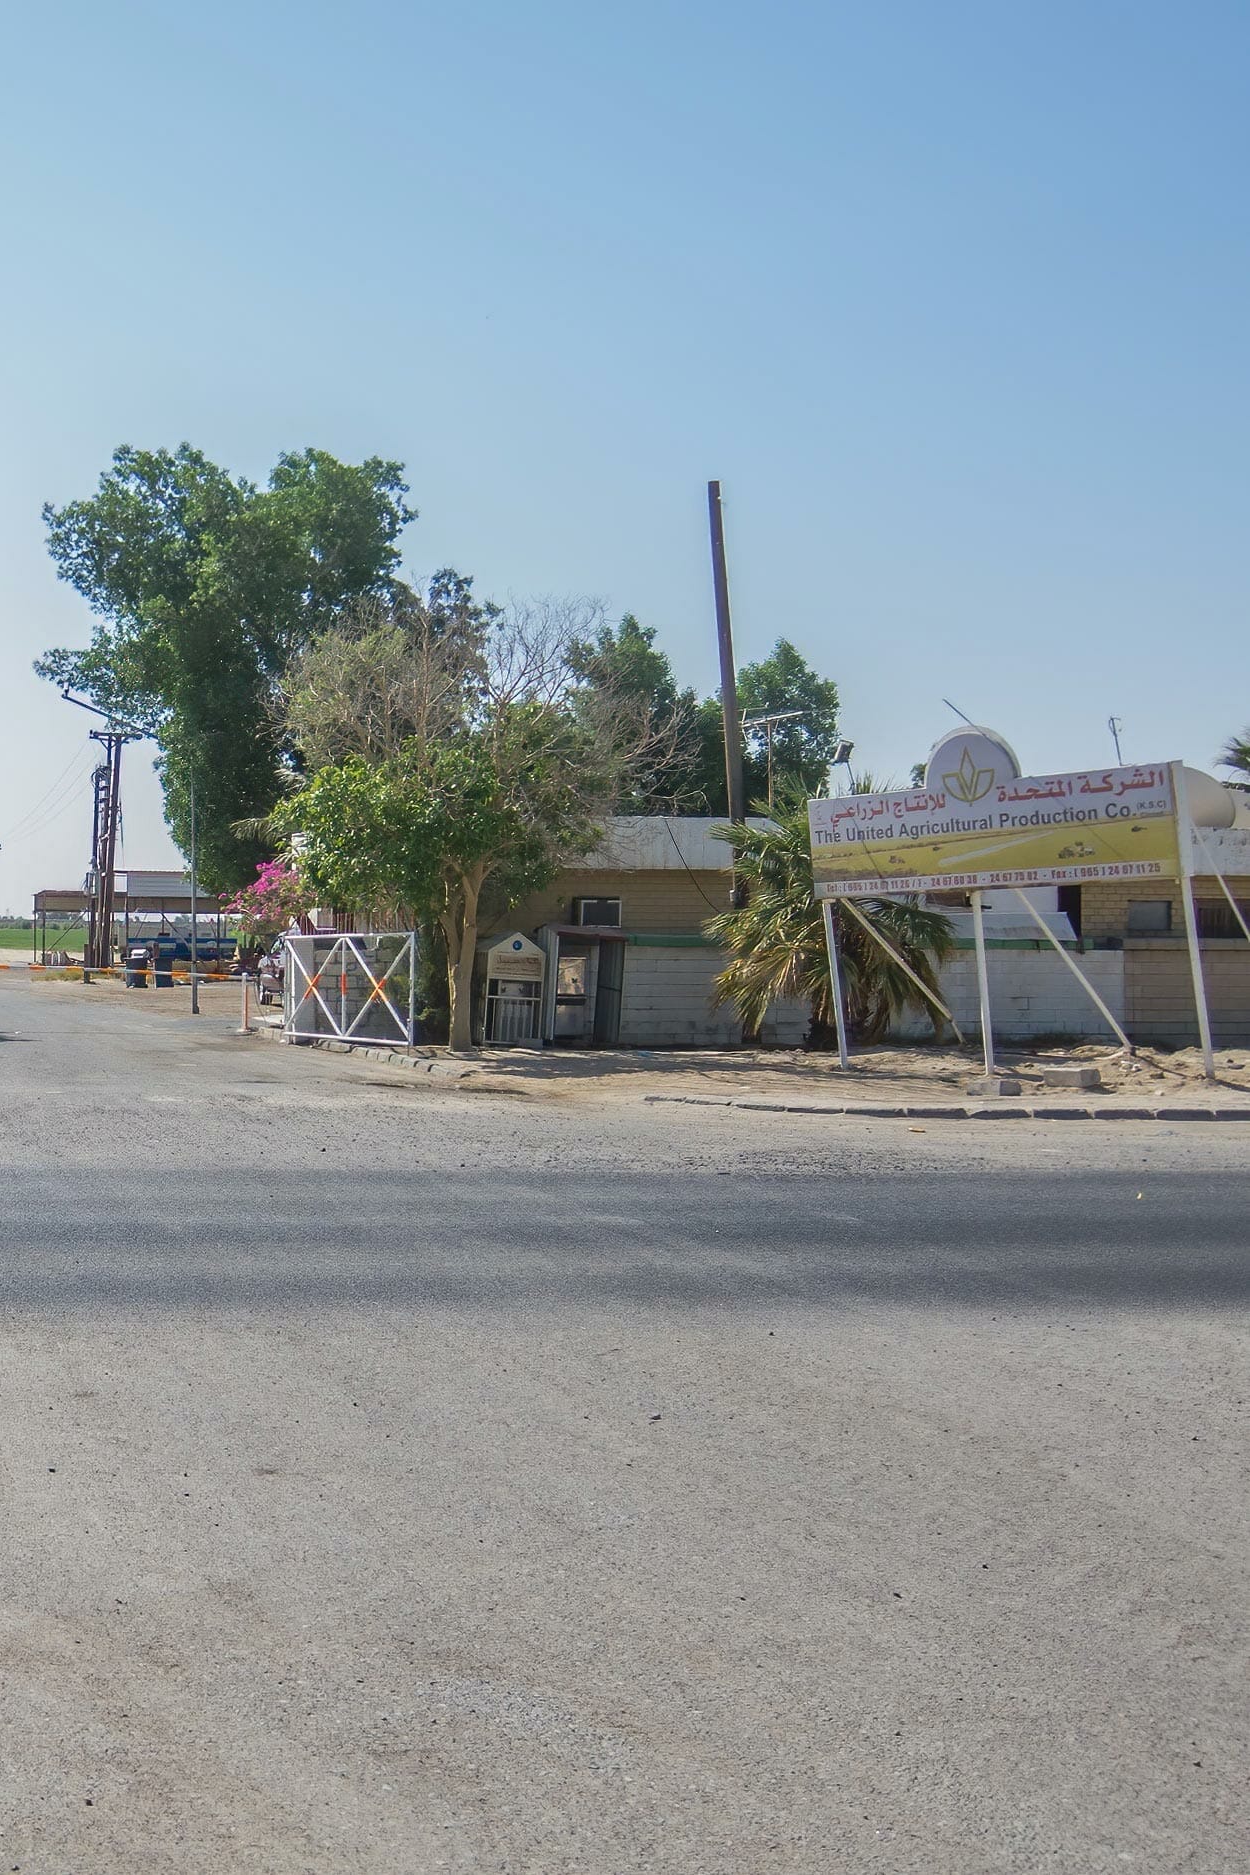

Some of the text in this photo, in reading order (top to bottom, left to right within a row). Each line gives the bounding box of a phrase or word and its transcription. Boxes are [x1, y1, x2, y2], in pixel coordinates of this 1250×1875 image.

[996, 779, 1073, 802] المتحدة
[1077, 769, 1164, 796] الشركة
[815, 830, 841, 844] The
[846, 822, 894, 842] United
[899, 815, 993, 840] Agricultural
[999, 806, 1098, 828] Production
[1105, 803, 1137, 818] Co.
[830, 799, 889, 827] الزراعي
